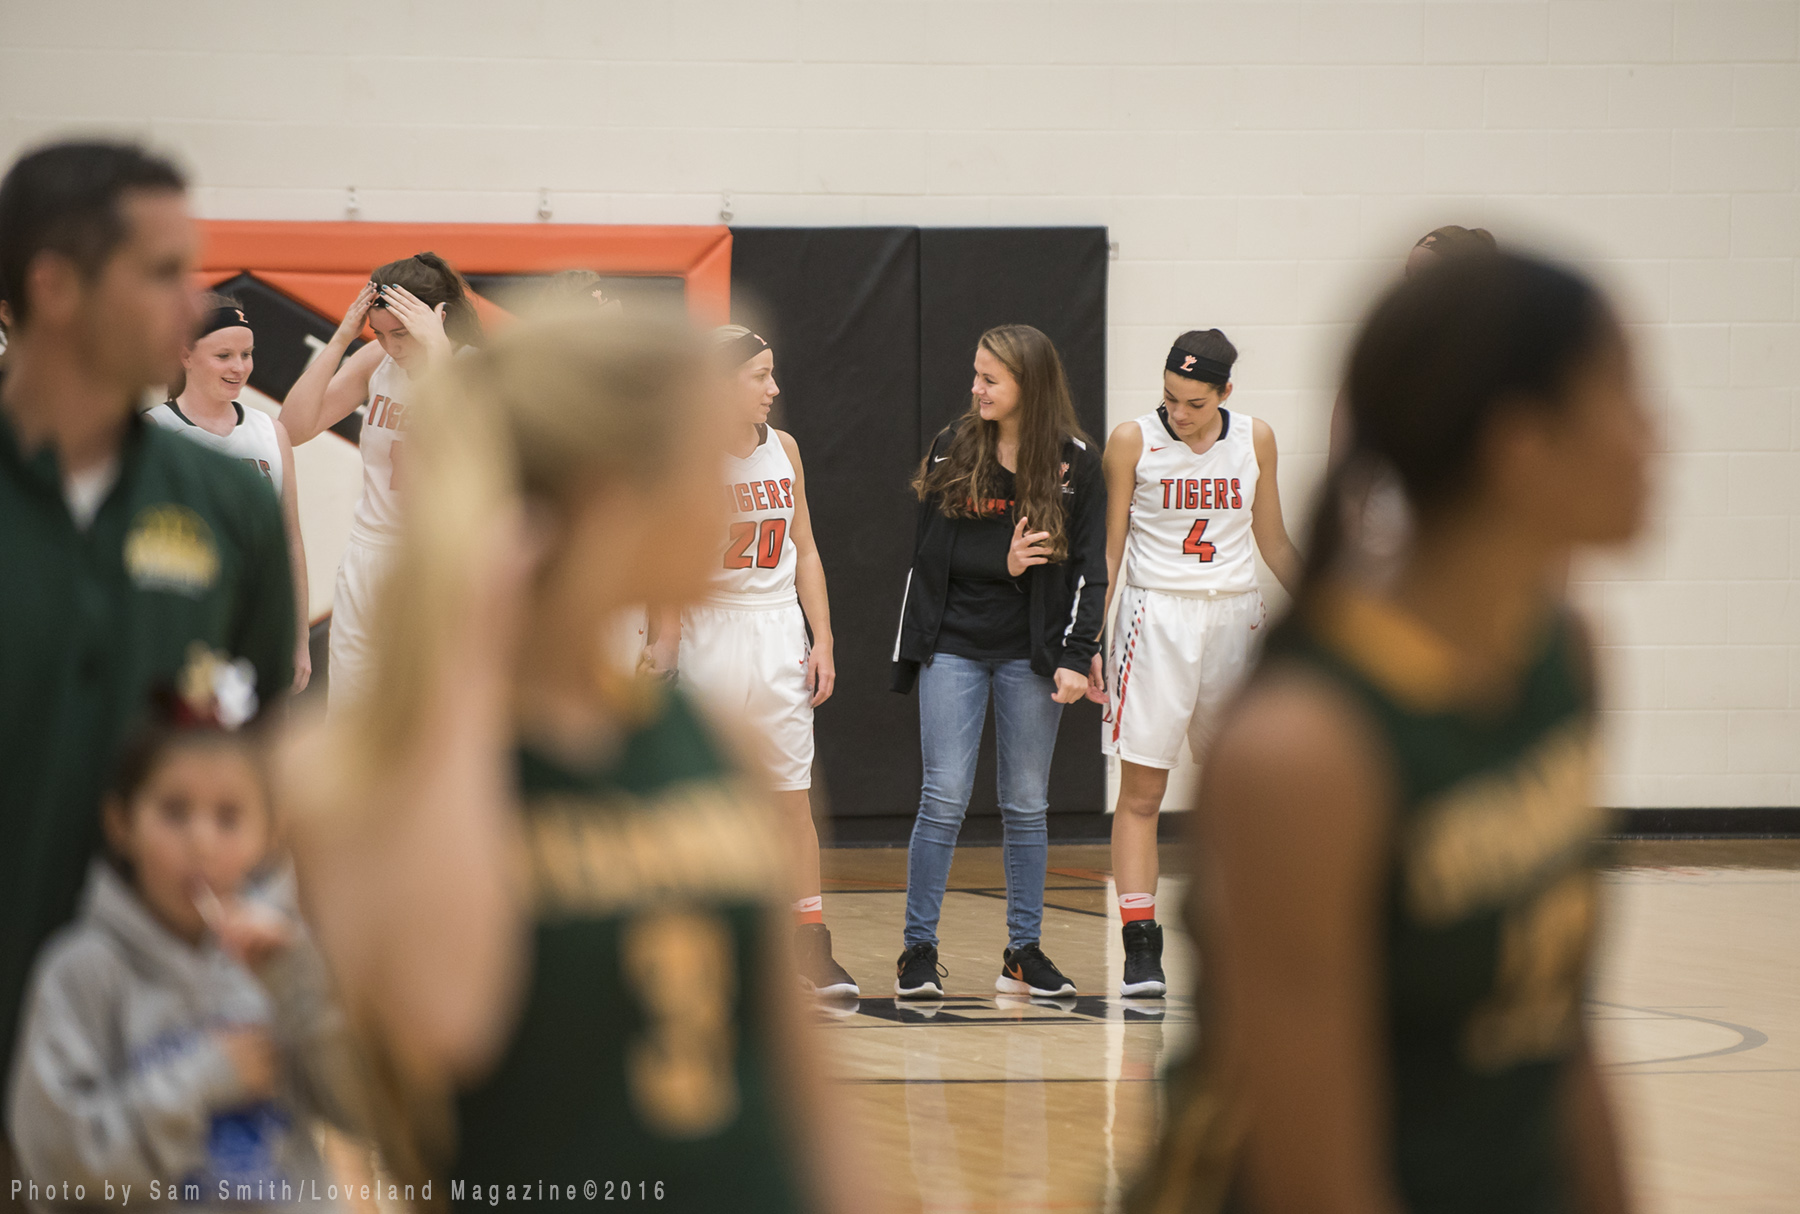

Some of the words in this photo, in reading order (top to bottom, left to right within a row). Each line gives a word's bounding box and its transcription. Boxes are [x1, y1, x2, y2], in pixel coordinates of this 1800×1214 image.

[725, 477, 793, 514] IGERS
[1160, 478, 1243, 510] TIGERS
[722, 517, 787, 570] 20
[1182, 518, 1217, 563] 4
